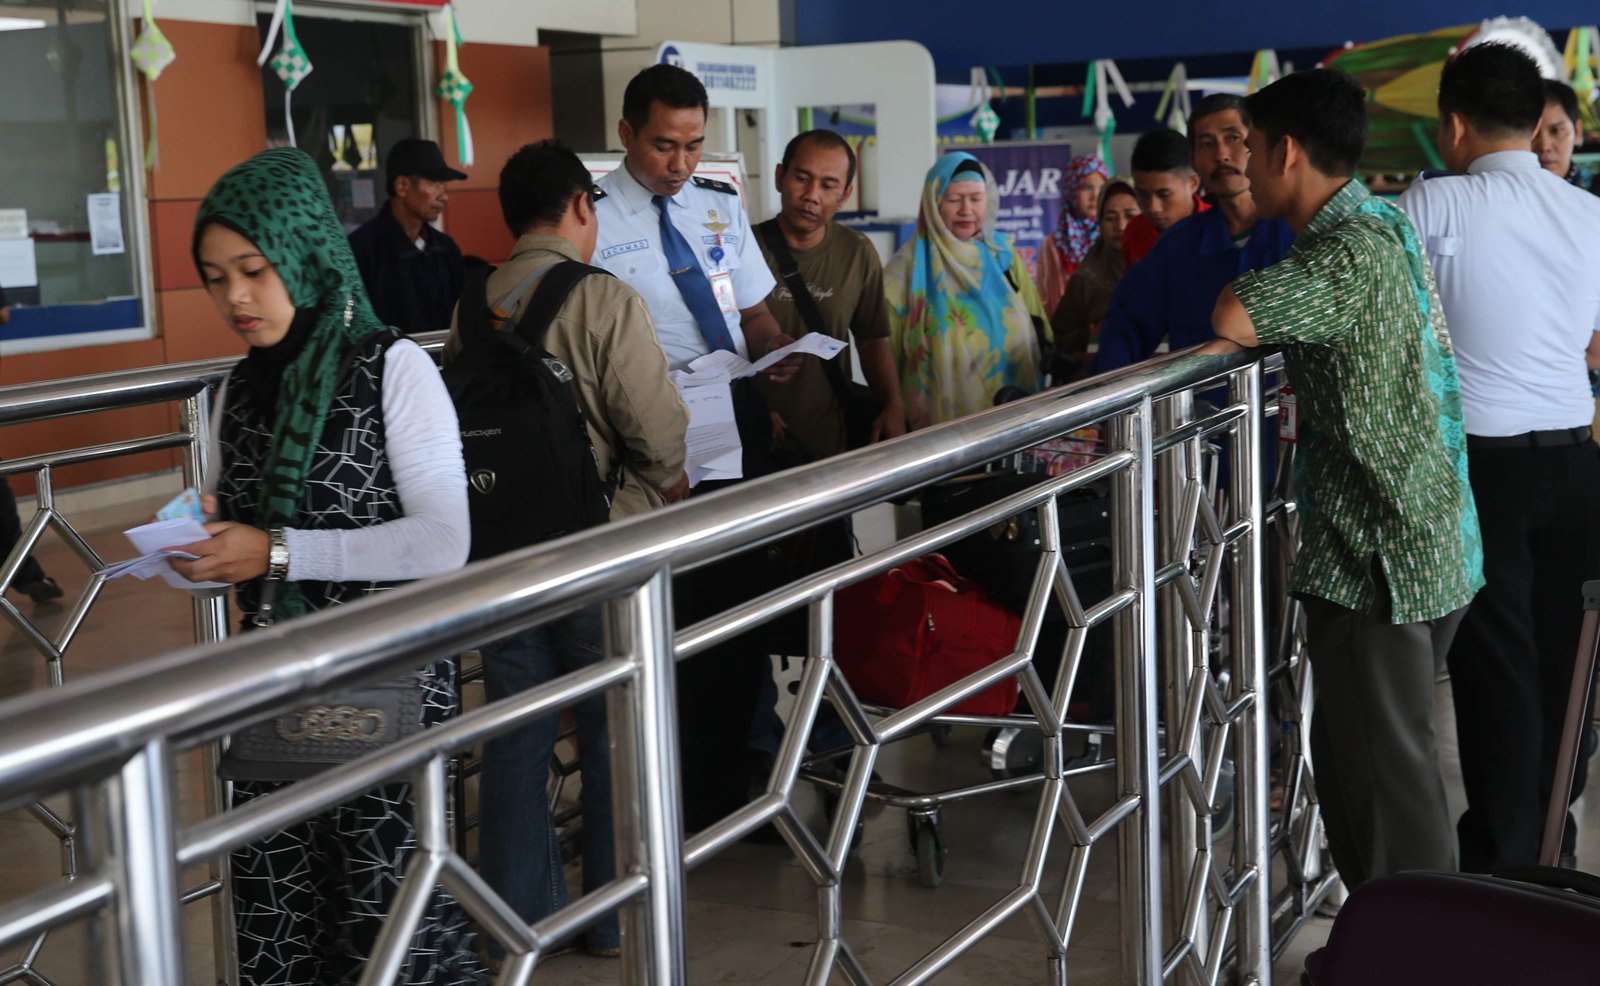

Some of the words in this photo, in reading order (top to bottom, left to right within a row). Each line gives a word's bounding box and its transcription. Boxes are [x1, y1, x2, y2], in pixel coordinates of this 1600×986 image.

[999, 168, 1062, 197] JAR
[606, 242, 646, 257] ACHMAD
[460, 428, 502, 437] RACKER
